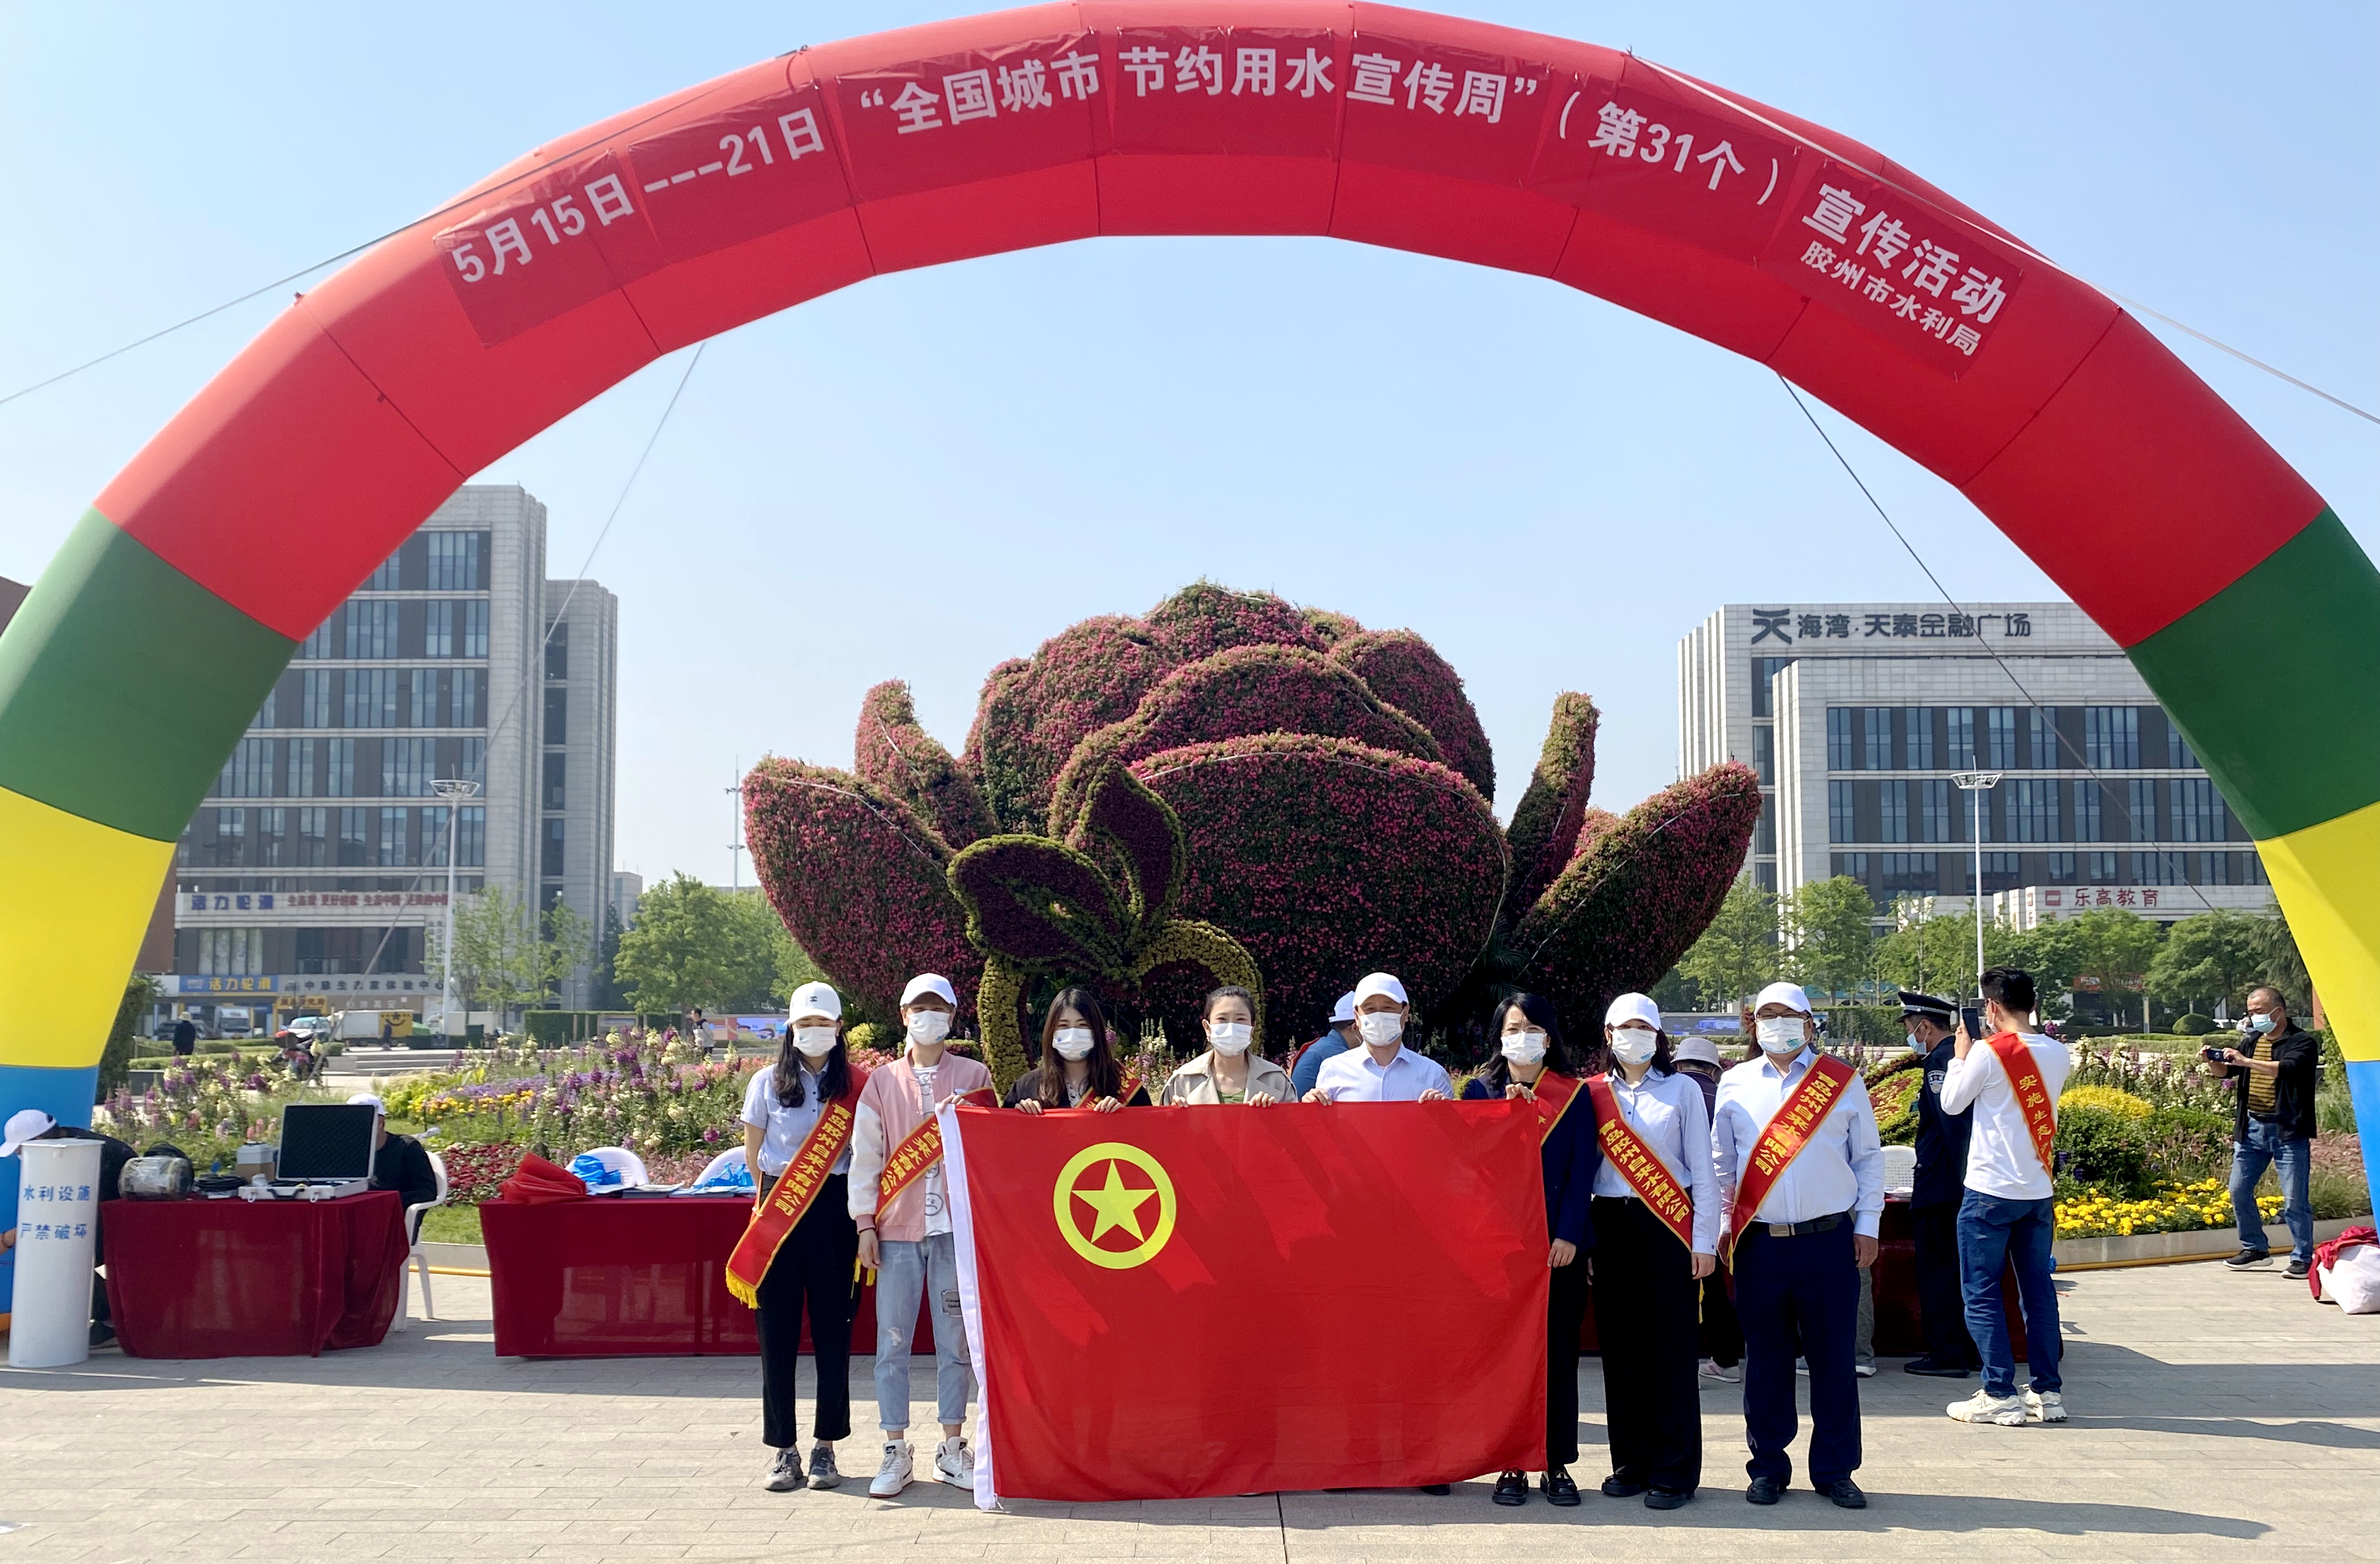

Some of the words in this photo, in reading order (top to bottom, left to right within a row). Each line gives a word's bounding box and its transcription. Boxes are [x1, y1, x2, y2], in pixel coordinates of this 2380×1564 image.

[1800, 240, 1981, 356] 胶州市水利局
[2075, 888, 2158, 907] 乐高教育
[209, 977, 271, 991] 活力轮滑
[1755, 1070, 1839, 1176] 青岛胶州自来水有限公司
[775, 1103, 852, 1216] 青岛胶州自来水有限公司
[1599, 1118, 1690, 1223] 青岛胶州自来水有限公司
[24, 1184, 90, 1201] 水利设施
[20, 1223, 87, 1240] 严禁破坏
